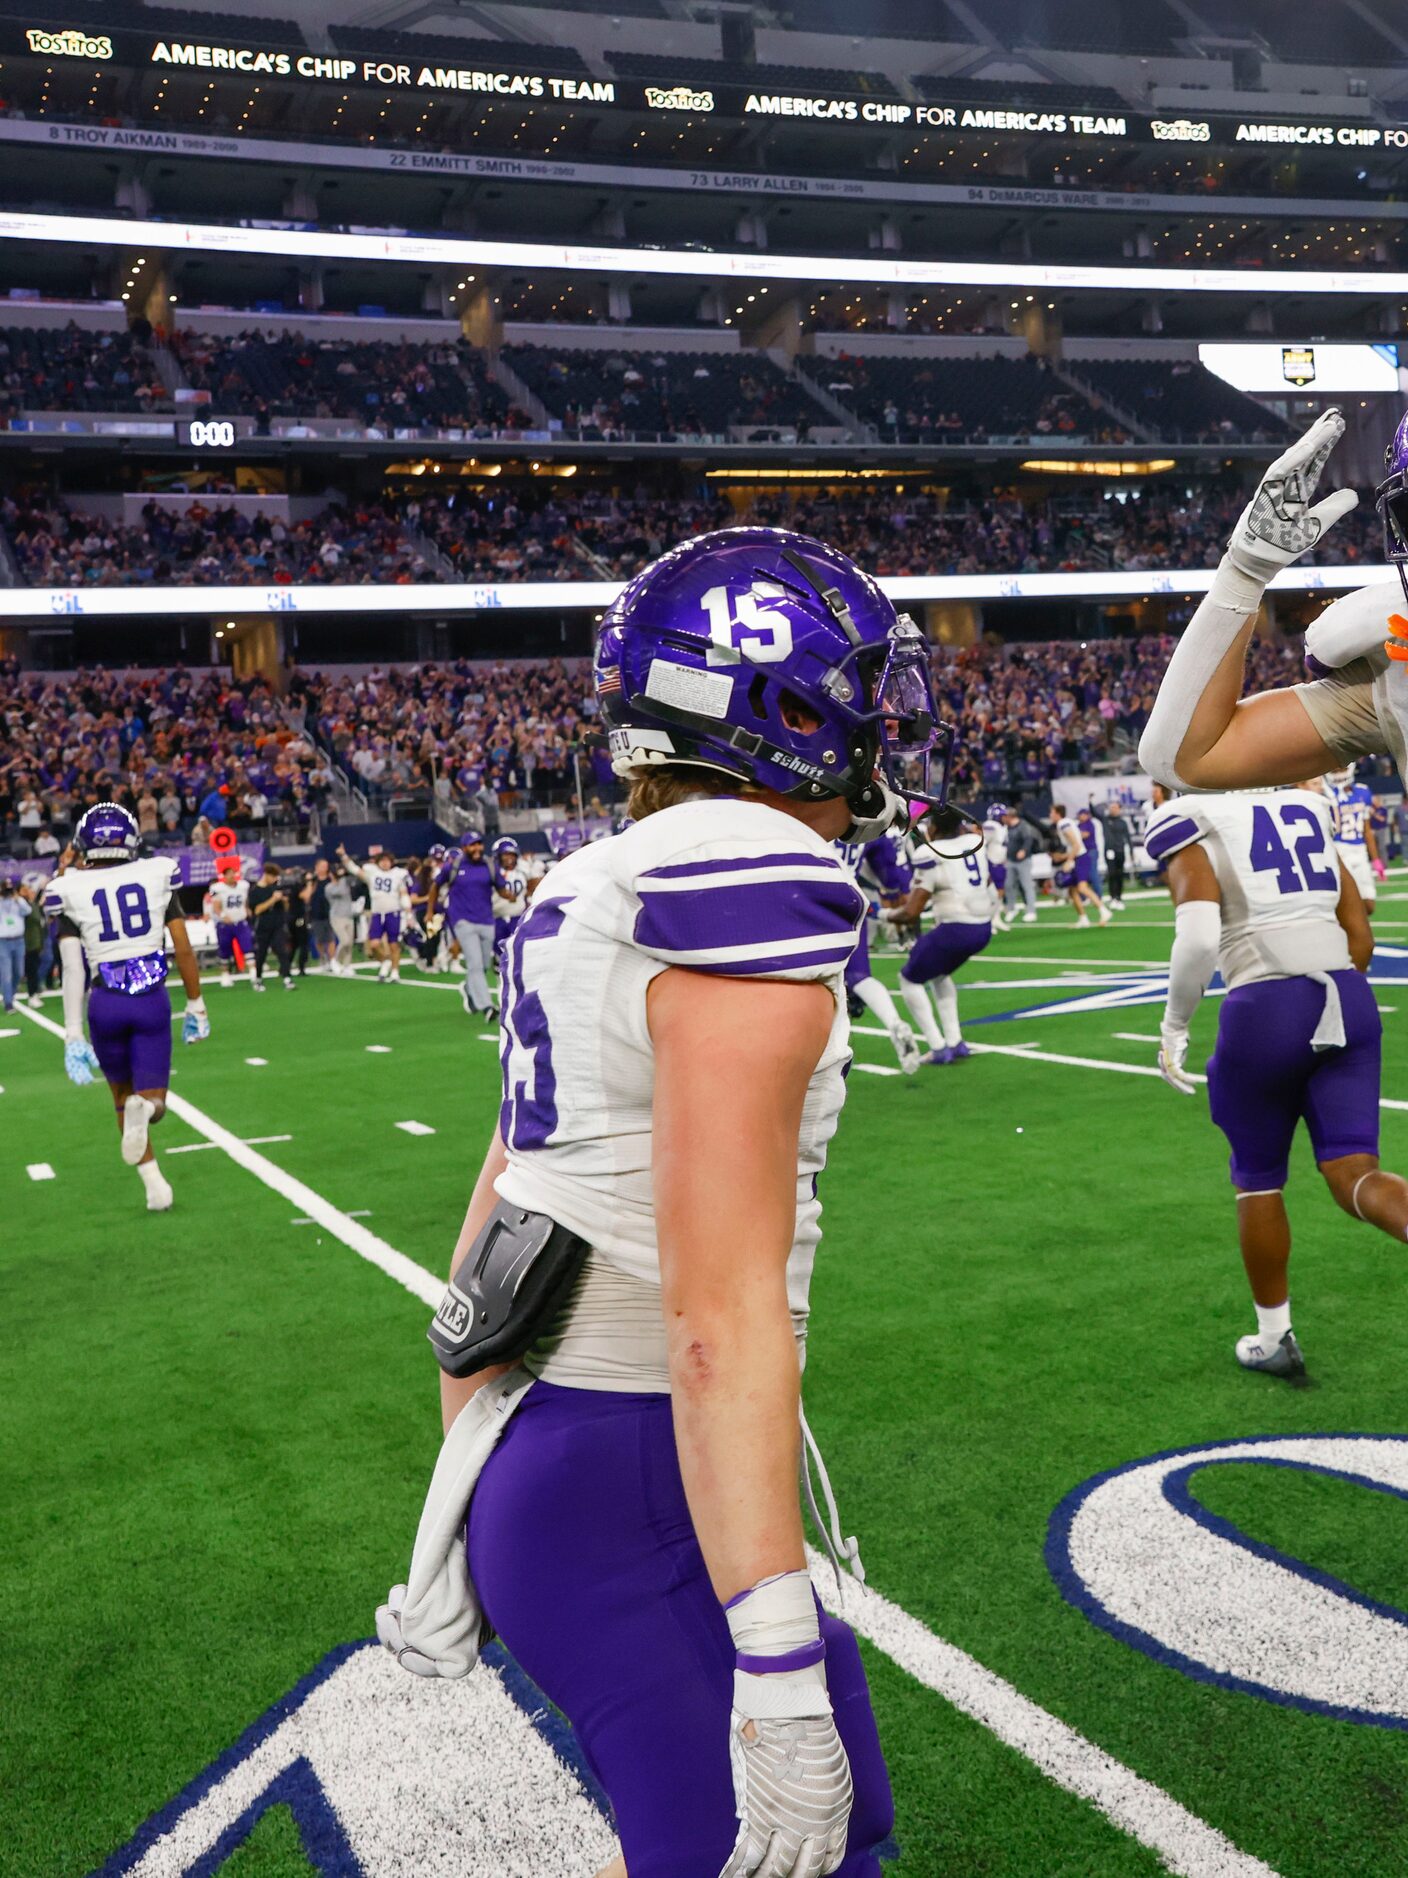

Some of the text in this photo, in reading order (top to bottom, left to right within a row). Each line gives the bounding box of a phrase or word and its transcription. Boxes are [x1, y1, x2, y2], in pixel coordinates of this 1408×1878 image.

[152, 43, 614, 101] AMERICA'S CHIP FOR AMERICA'S TEAM
[745, 95, 1126, 135] AMERICA'S CHIP FOR AMERICA'S TEAM
[50, 127, 59, 139] 8
[64, 128, 109, 144] TROY
[113, 133, 177, 149] AIKMAN
[1236, 125, 1334, 144] AMERICA'S
[1337, 128, 1380, 145] CHIP
[390, 154, 406, 167] 22
[412, 156, 471, 171] EMMITT
[476, 161, 522, 174] SMITH
[690, 173, 709, 187] 73
[714, 176, 759, 190] LARRY
[763, 179, 808, 192] ALLEN
[968, 188, 983, 201] 94
[1062, 192, 1098, 206] WARE
[190, 421, 235, 447] 0:00
[700, 581, 794, 668] 15
[676, 666, 709, 680] WARNING
[1250, 804, 1338, 895] 42
[374, 877, 393, 893] 99
[92, 883, 152, 943] 18
